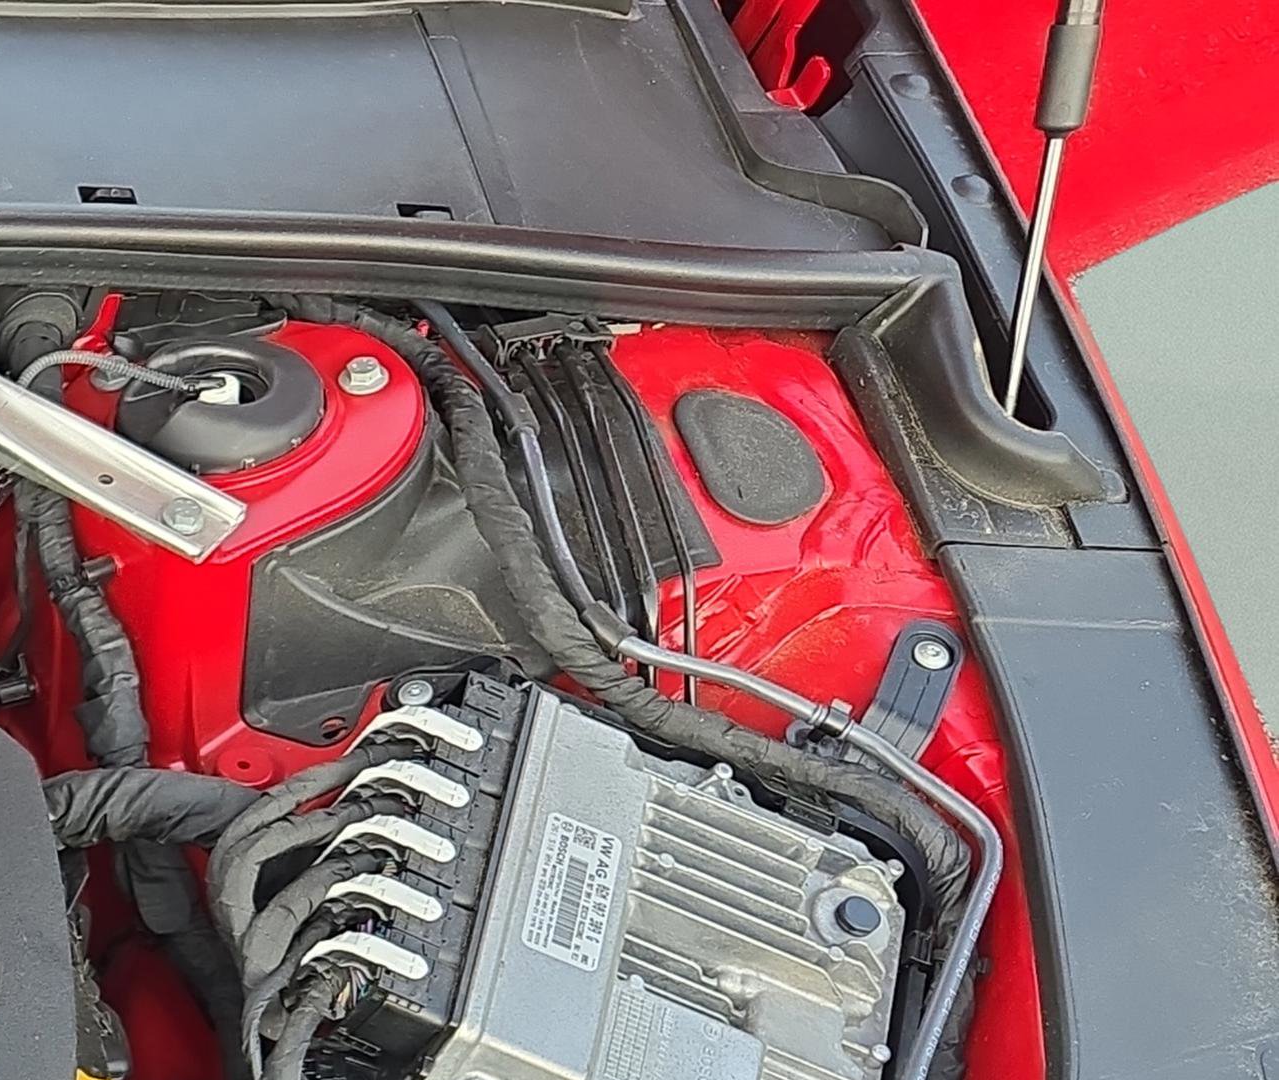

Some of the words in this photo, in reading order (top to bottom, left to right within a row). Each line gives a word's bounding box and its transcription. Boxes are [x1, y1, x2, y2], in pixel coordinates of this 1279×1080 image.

[554, 834, 569, 866] BOSCH
[598, 835, 614, 858] VW
[595, 858, 609, 879] AG
